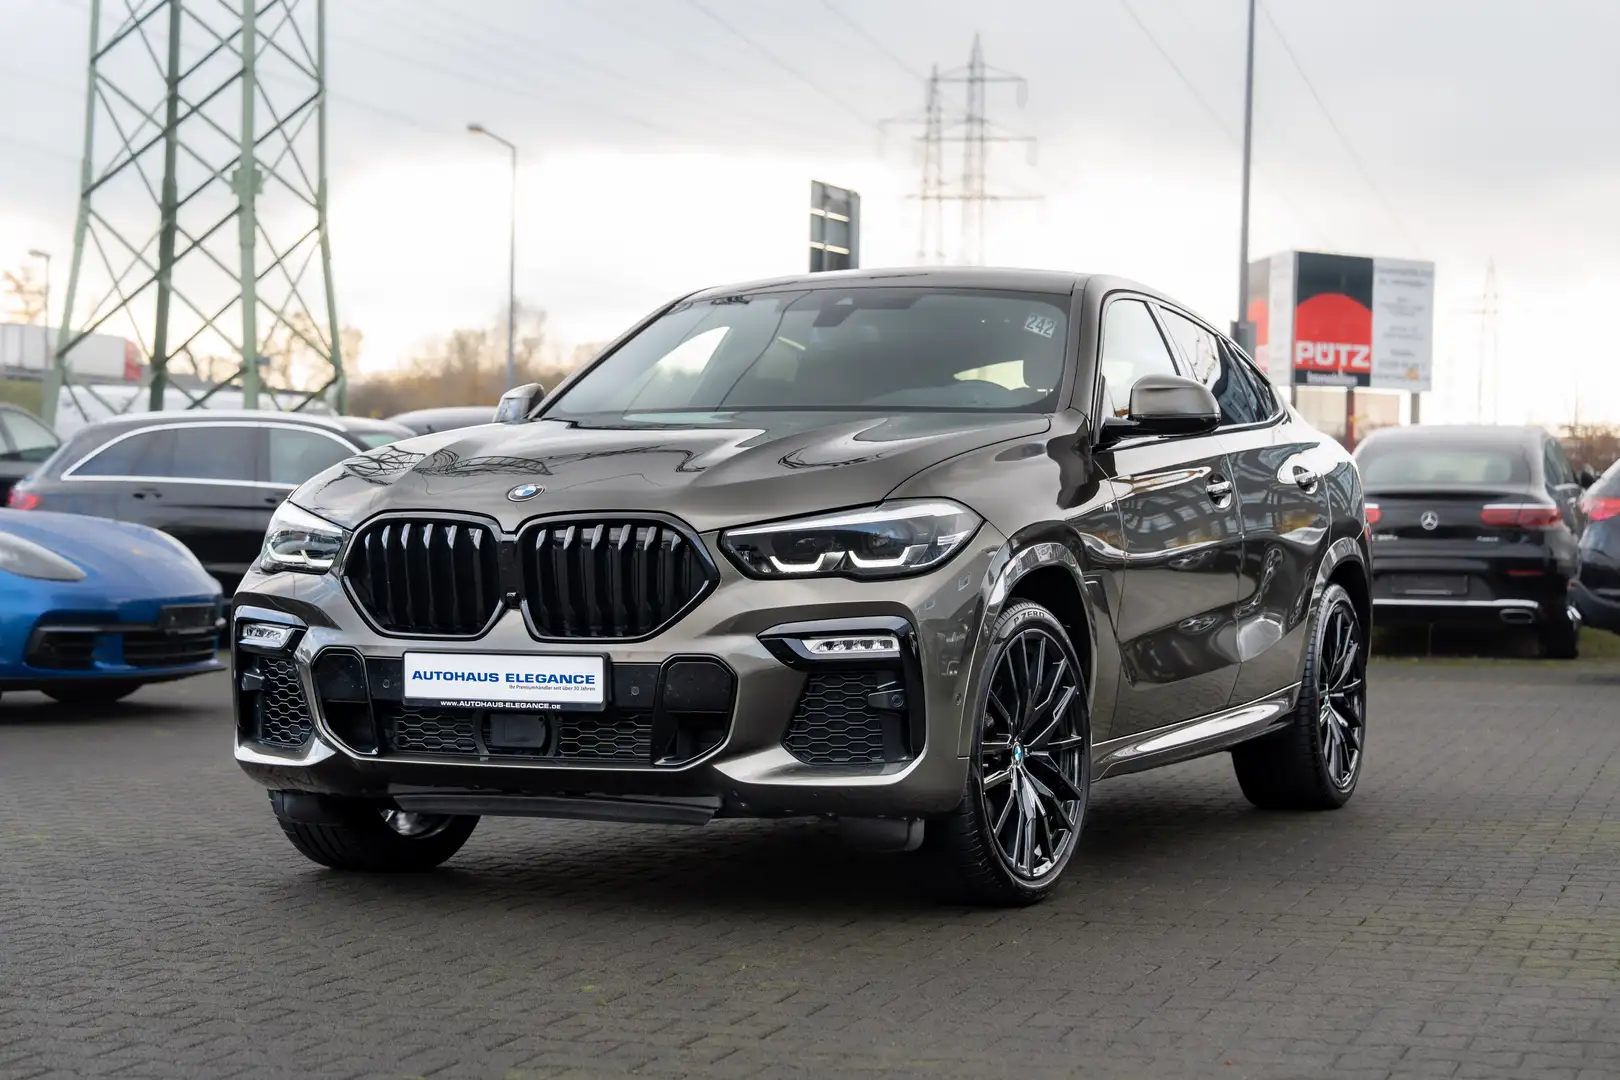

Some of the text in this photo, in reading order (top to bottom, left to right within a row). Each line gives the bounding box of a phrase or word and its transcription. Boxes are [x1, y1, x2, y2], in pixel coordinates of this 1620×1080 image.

[1026, 314, 1054, 336] 242
[1295, 341, 1370, 368] PÜTZ
[1014, 616, 1020, 626] P
[412, 670, 595, 684] AUTOHAUS ELEGANCE
